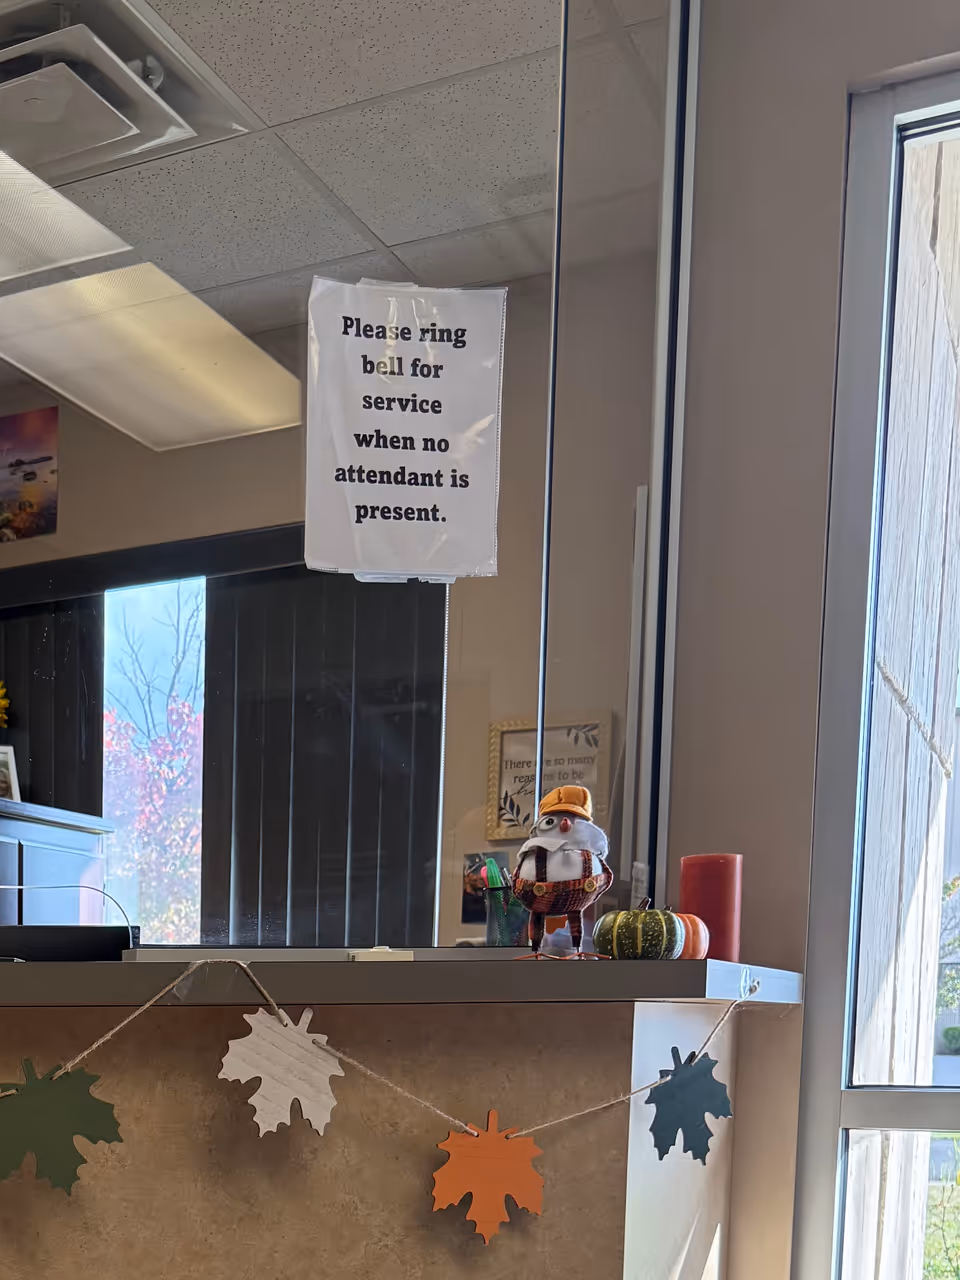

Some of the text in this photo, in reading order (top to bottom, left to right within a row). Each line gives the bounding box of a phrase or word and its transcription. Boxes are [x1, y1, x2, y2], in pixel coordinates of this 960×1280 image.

[342, 316, 467, 348] Please ring
[361, 355, 443, 378] bell for
[362, 393, 442, 414] service
[354, 429, 450, 452] when no
[334, 465, 470, 488] attendant is
[355, 504, 447, 524] present.
[504, 760, 532, 770] There
[567, 755, 596, 766] many
[513, 771, 556, 784] reasns
